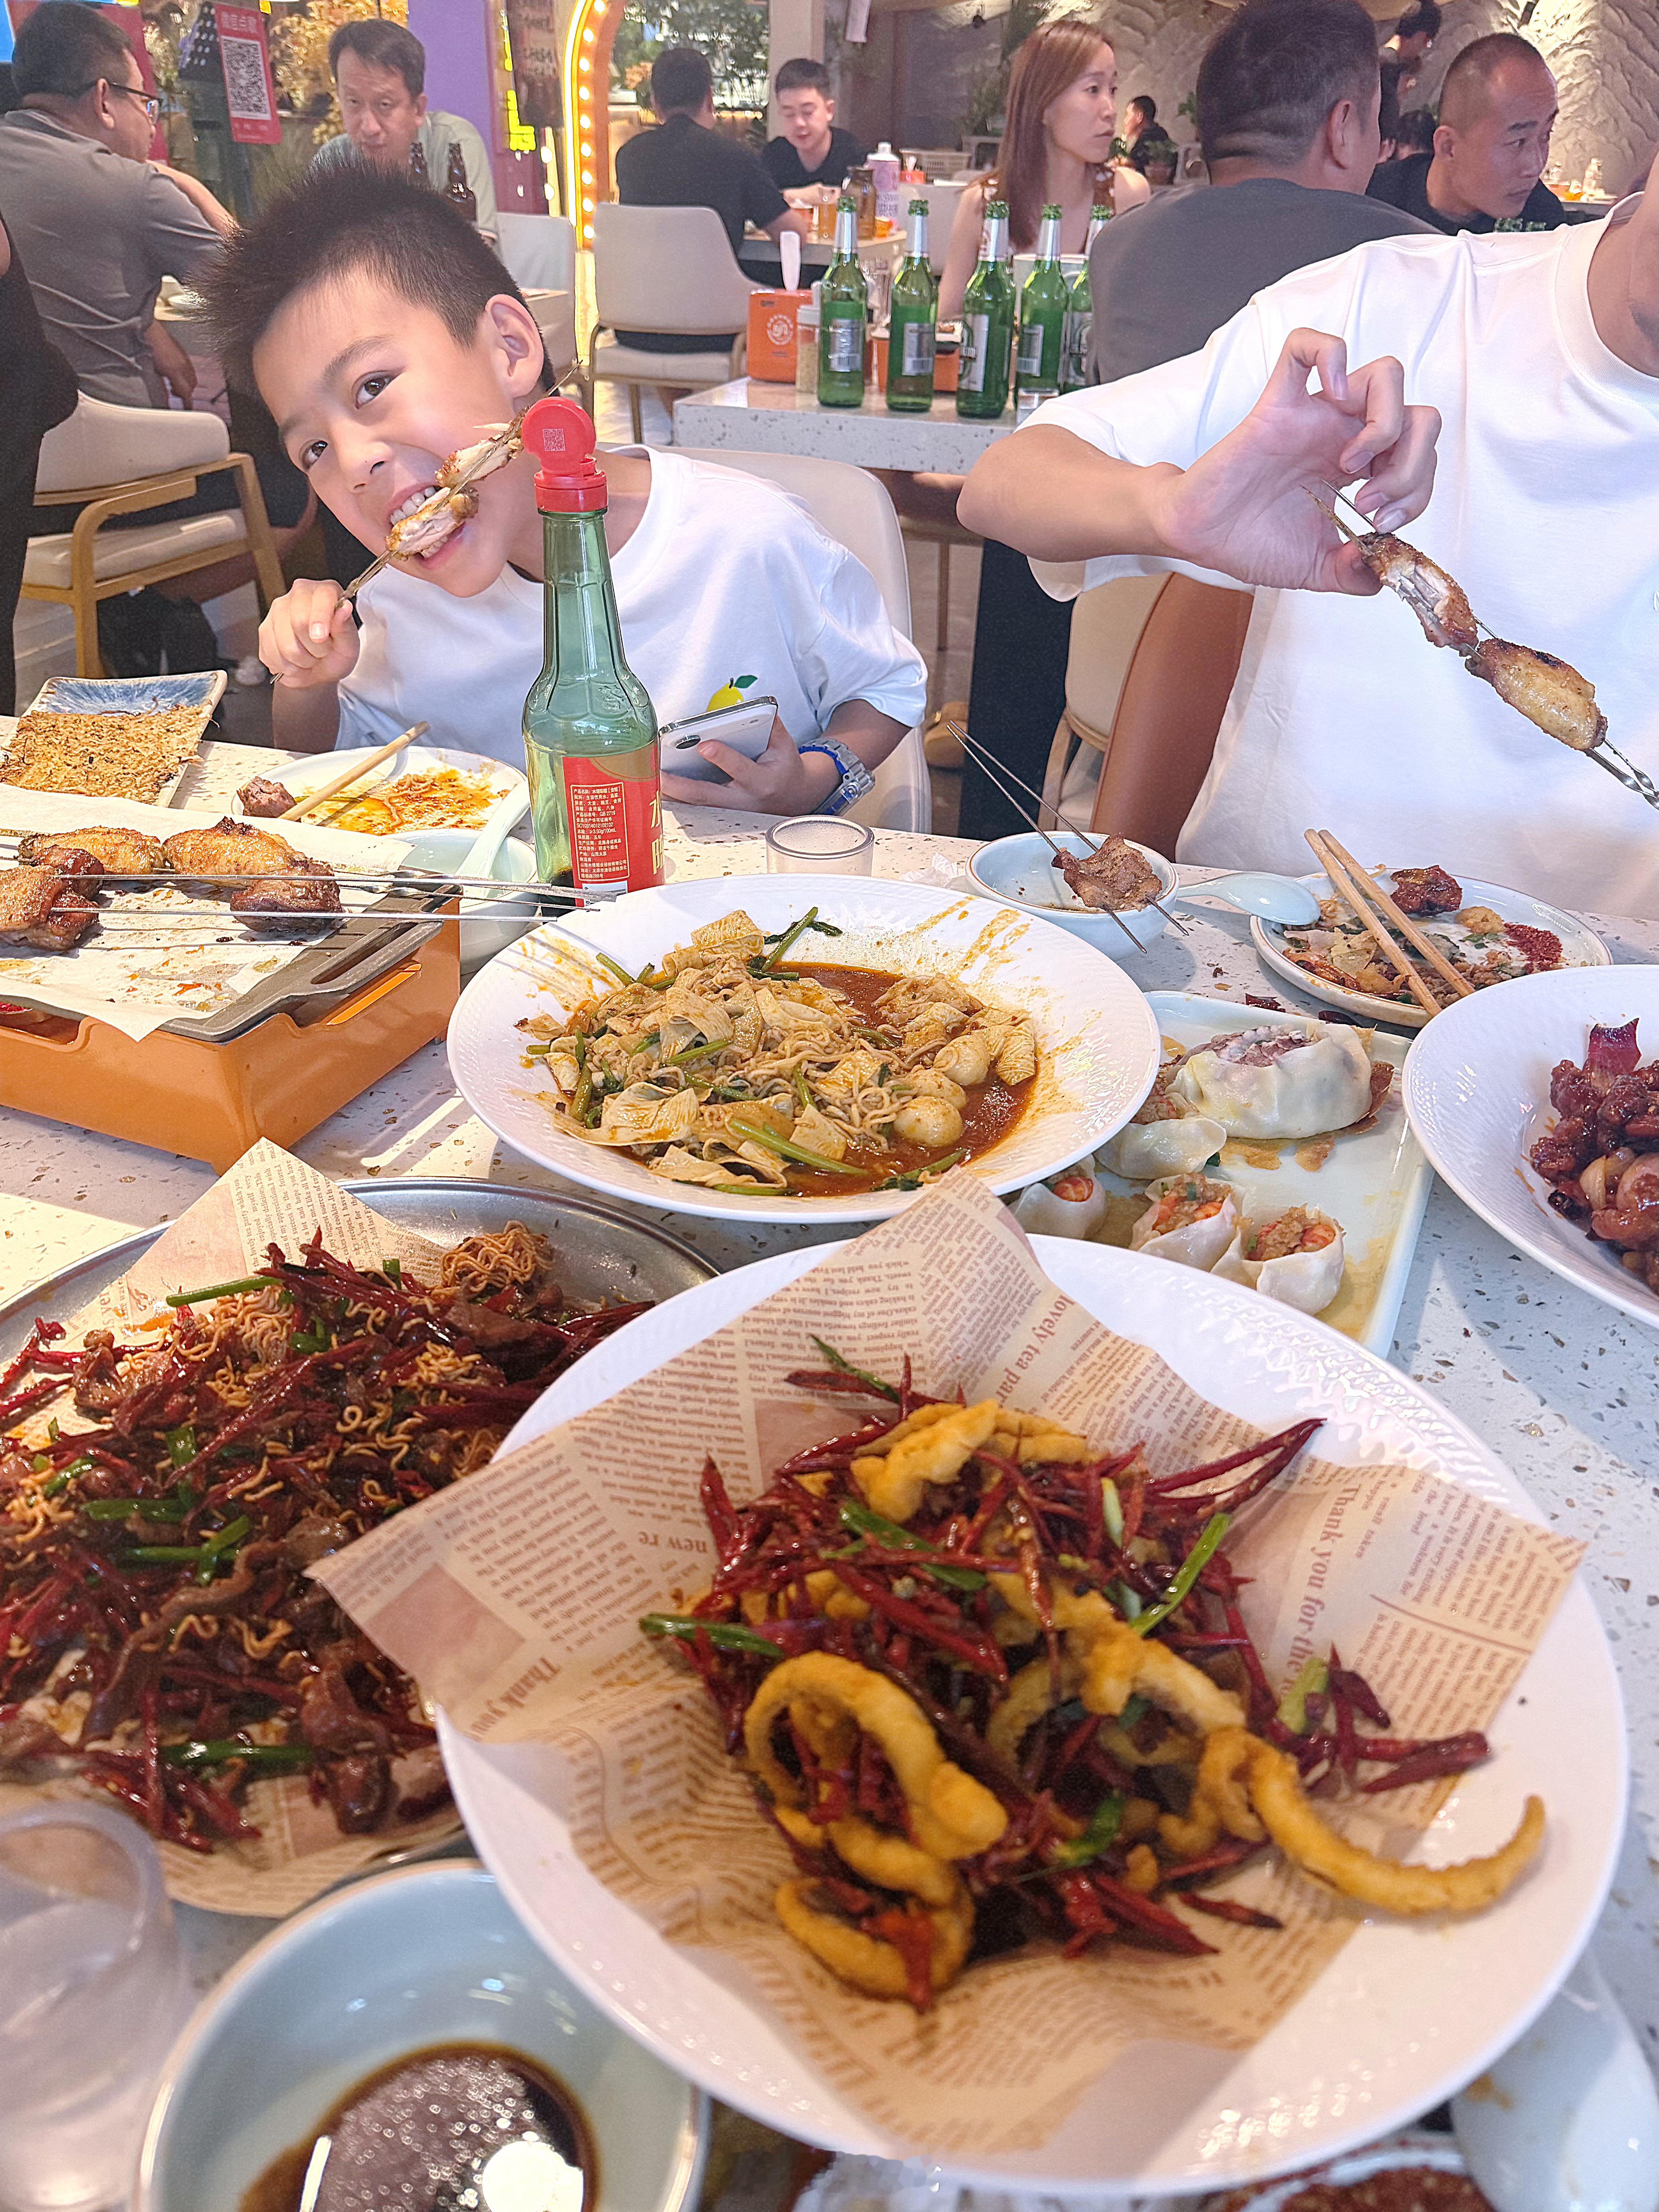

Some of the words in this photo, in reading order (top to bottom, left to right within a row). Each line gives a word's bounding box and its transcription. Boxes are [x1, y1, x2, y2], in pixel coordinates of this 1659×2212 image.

[264, 1168, 273, 1181] wish
[284, 1159, 294, 1174] have
[297, 1165, 307, 1181] kinds
[234, 1178, 242, 1190] you
[244, 1174, 253, 1188] very
[289, 1175, 299, 1186] you
[235, 1191, 246, 1209] which
[247, 1192, 259, 1212] myself
[281, 1191, 289, 1201] the
[292, 1188, 303, 1204] hope
[303, 1191, 312, 1202] like
[316, 1192, 327, 1214] sources
[338, 1195, 348, 1210] have
[240, 1210, 251, 1226] party
[297, 1206, 305, 1219] and
[330, 1203, 341, 1225] cookies
[366, 1214, 374, 1226] last
[254, 1218, 266, 1242] enjoyed
[279, 1224, 287, 1234] my
[287, 1212, 298, 1234] success
[322, 1214, 335, 1238] biggest
[358, 1221, 367, 1233] you
[368, 1226, 378, 1240] held
[246, 1237, 258, 1256] lovely
[283, 1242, 293, 1259] token
[329, 1238, 338, 1248] my
[339, 1238, 349, 1255] cakes
[360, 1235, 372, 1254] Thank
[331, 1247, 338, 1256] of
[251, 1256, 260, 1267] the
[1031, 1295, 1075, 1343] lovely
[1016, 1345, 1040, 1371] tea
[1321, 1483, 1360, 1542] Thank
[667, 1535, 709, 1555] new
[1307, 1547, 1330, 1588] you
[1298, 1596, 1324, 1631] for
[1287, 1637, 1313, 1672] the
[504, 1657, 560, 1708] Thank
